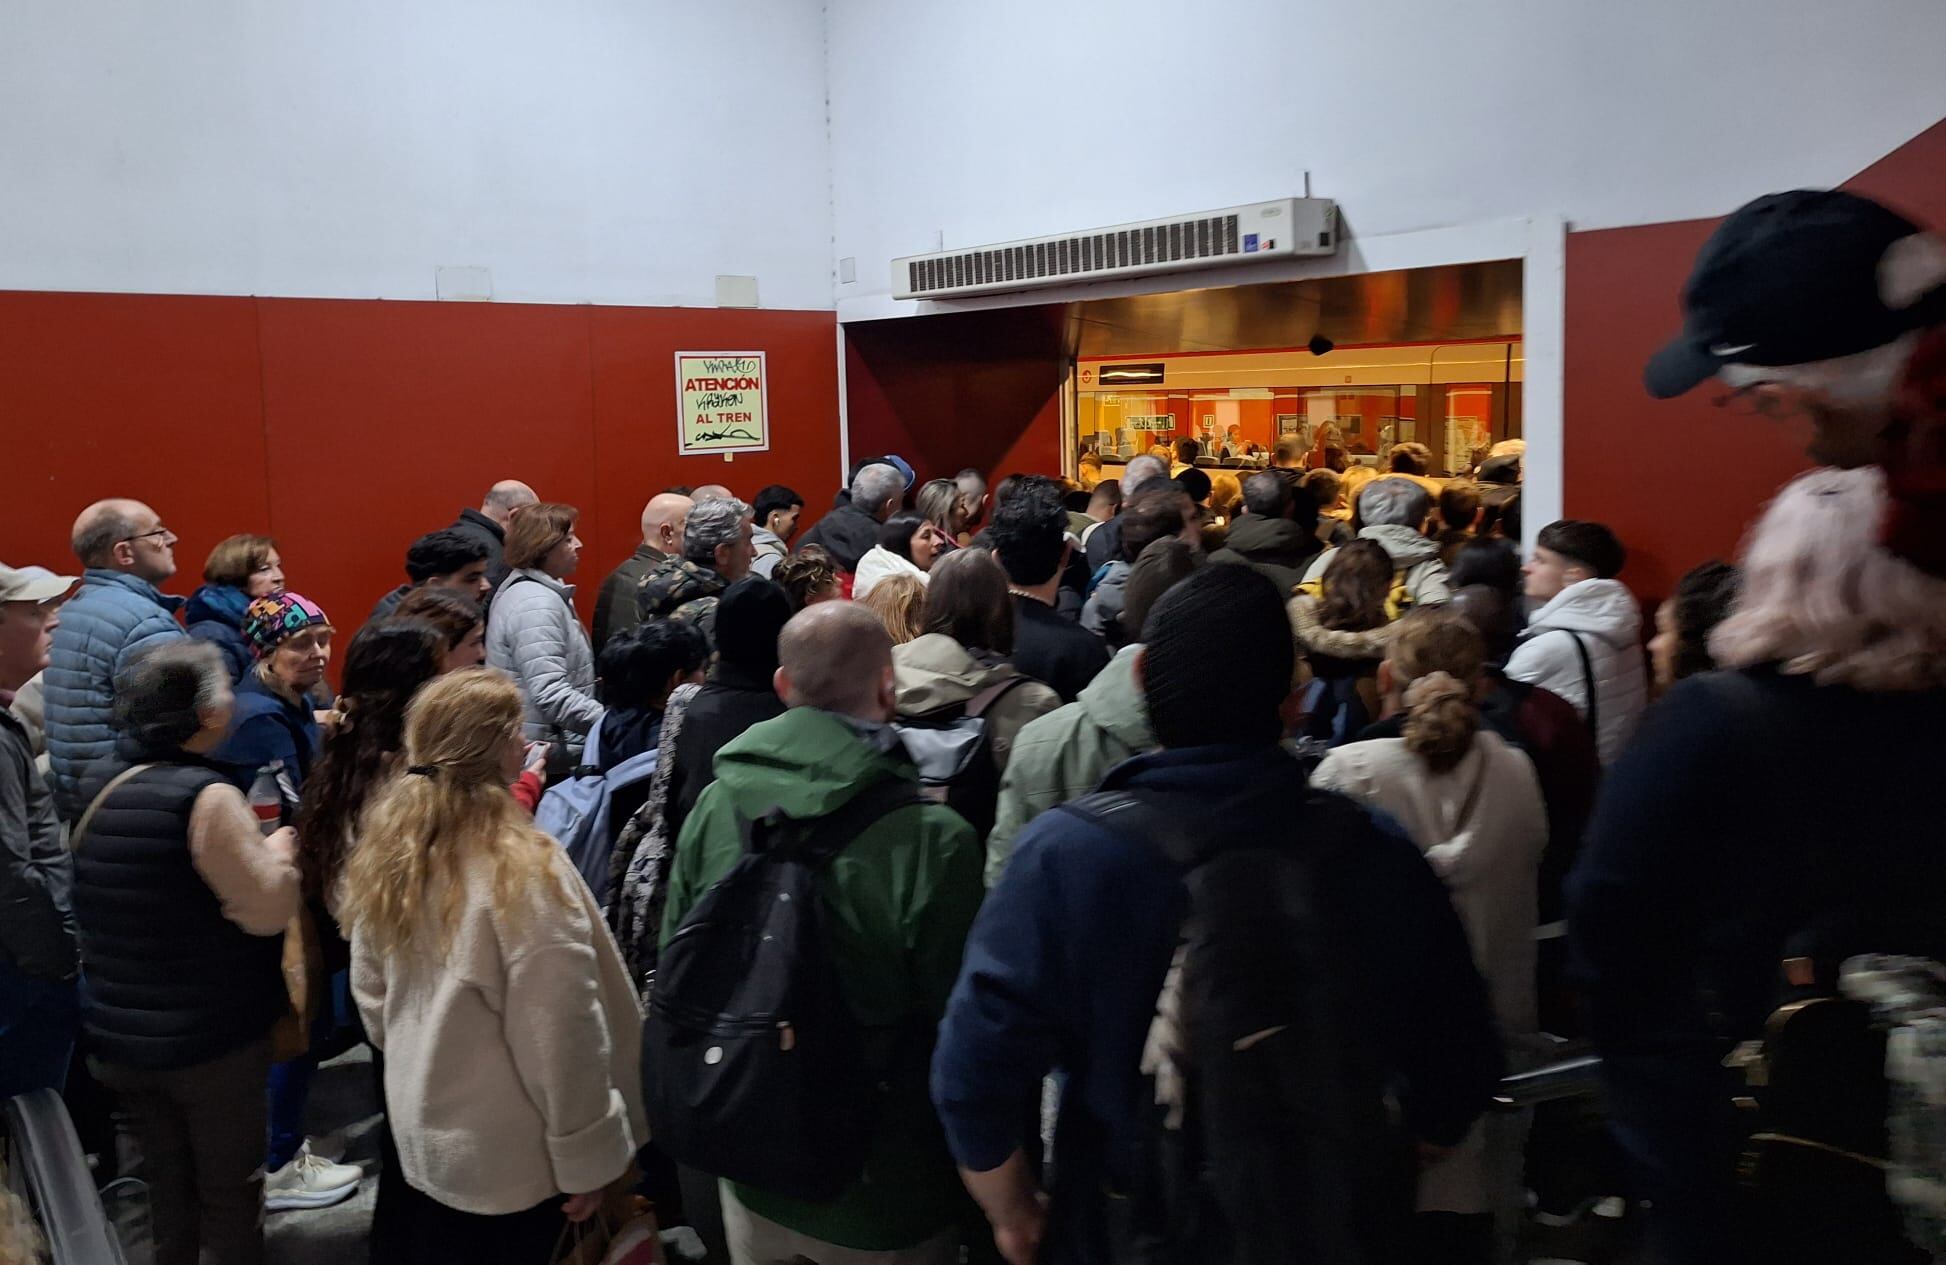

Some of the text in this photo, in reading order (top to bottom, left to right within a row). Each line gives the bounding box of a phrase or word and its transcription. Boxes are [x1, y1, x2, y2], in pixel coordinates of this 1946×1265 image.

[684, 374, 759, 391] ATENCIÓN
[696, 411, 752, 424] AL TREN
